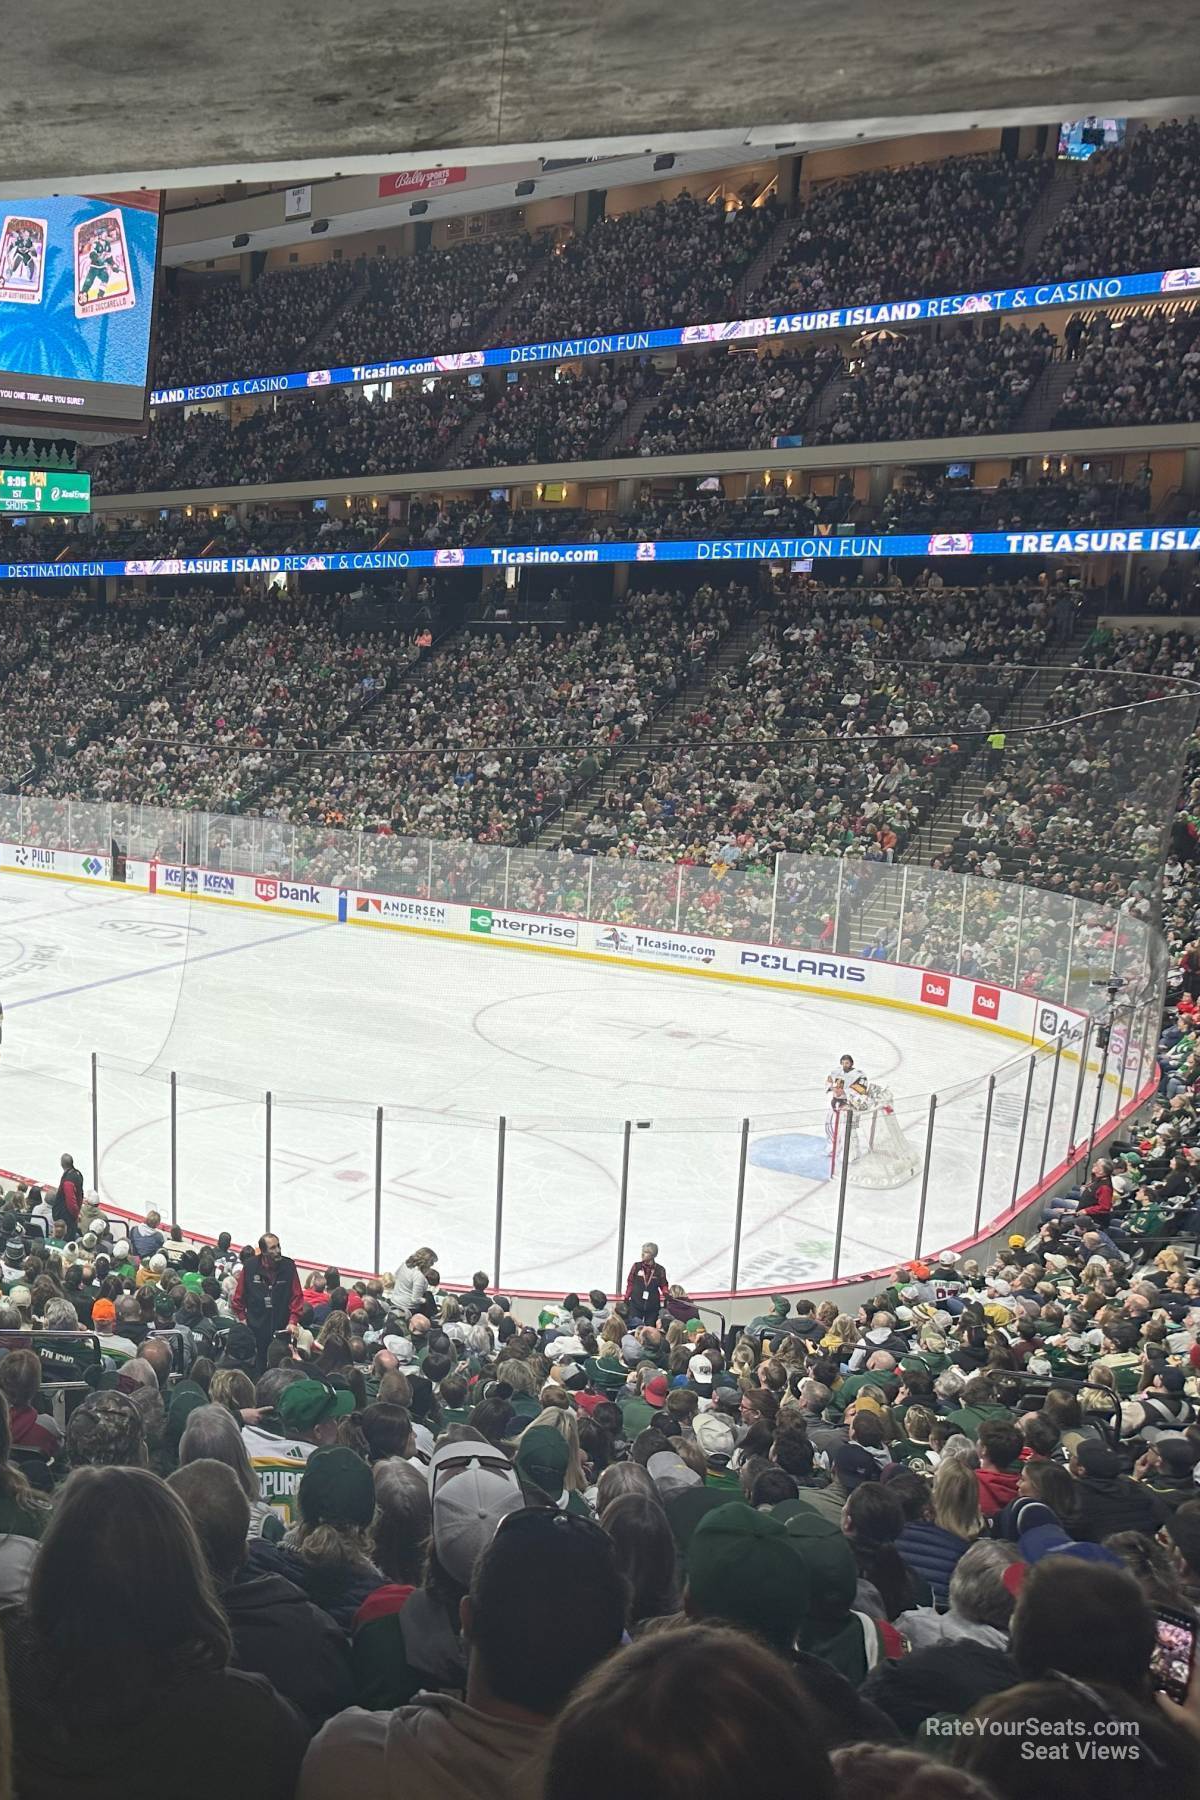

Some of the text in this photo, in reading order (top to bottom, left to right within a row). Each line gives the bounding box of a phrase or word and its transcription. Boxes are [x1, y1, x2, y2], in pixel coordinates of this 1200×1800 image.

[395, 170, 450, 189] Bally SPORTS
[741, 278, 1122, 338] TREASURE ISLAND RESORT & CASINO
[510, 334, 650, 364] DESTINATION FUN
[352, 360, 436, 381] TIcasino.com
[0, 390, 12, 398] YOU
[14, 391, 26, 400] ONE
[27, 392, 41, 402] TIME,
[42, 394, 53, 402] ARE
[54, 395, 66, 404] YOU
[67, 396, 85, 405] SURE?
[188, 384, 229, 400] RESORT
[232, 383, 240, 395] &
[243, 376, 289, 393] CASINO
[7, 476, 26, 487] 9:06
[35, 486, 41, 500] 0
[6, 501, 28, 510] SHOTS
[36, 502, 40, 511] 3
[697, 538, 883, 560] DESTINATION FUN
[1006, 531, 1140, 553] TREASURE
[166, 552, 409, 574] TREASURE ISLAND RESORT & CASINO
[492, 548, 599, 564] TIcasino.com
[8, 564, 104, 578] DESTINATION FUN
[32, 848, 55, 864] PILOT
[256, 883, 320, 904] us bank
[384, 901, 444, 917] ANDERSEN
[474, 913, 576, 938] enterprise
[636, 936, 716, 956] TIcasino.com
[740, 950, 866, 982] POLARIS
[926, 983, 945, 996] Cub
[978, 996, 995, 1009] Cub
